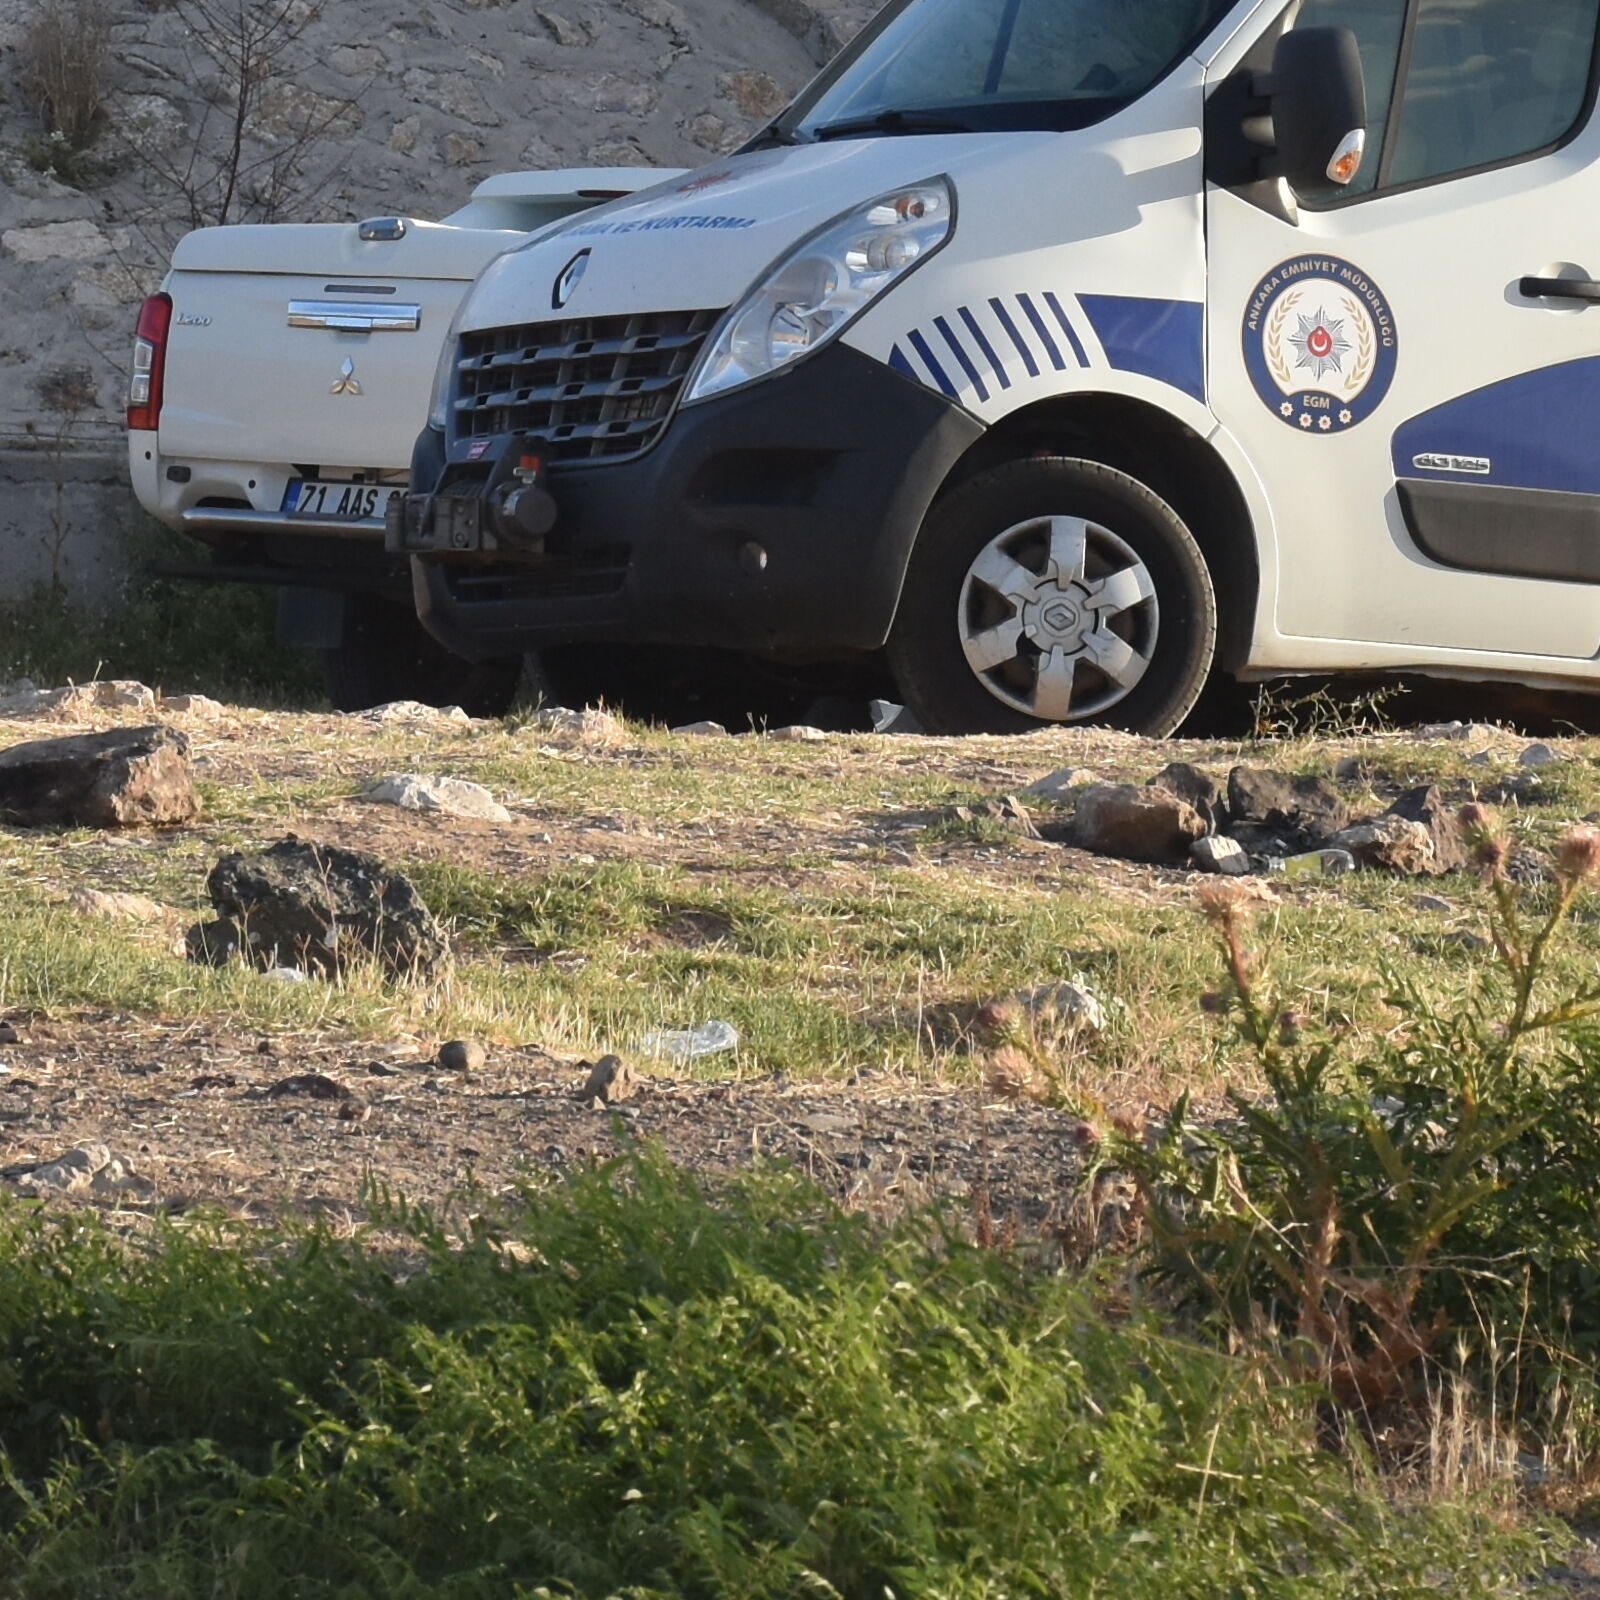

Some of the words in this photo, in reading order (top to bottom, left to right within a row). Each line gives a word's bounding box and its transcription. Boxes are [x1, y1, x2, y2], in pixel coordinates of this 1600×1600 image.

[1248, 276, 1281, 331] ANKARA
[1281, 259, 1338, 280] EMNİYET
[1340, 268, 1394, 347] MÜDÜRLÜĞÜ
[1303, 394, 1330, 409] EGM
[298, 485, 328, 512] 71
[336, 487, 379, 515] AAS
